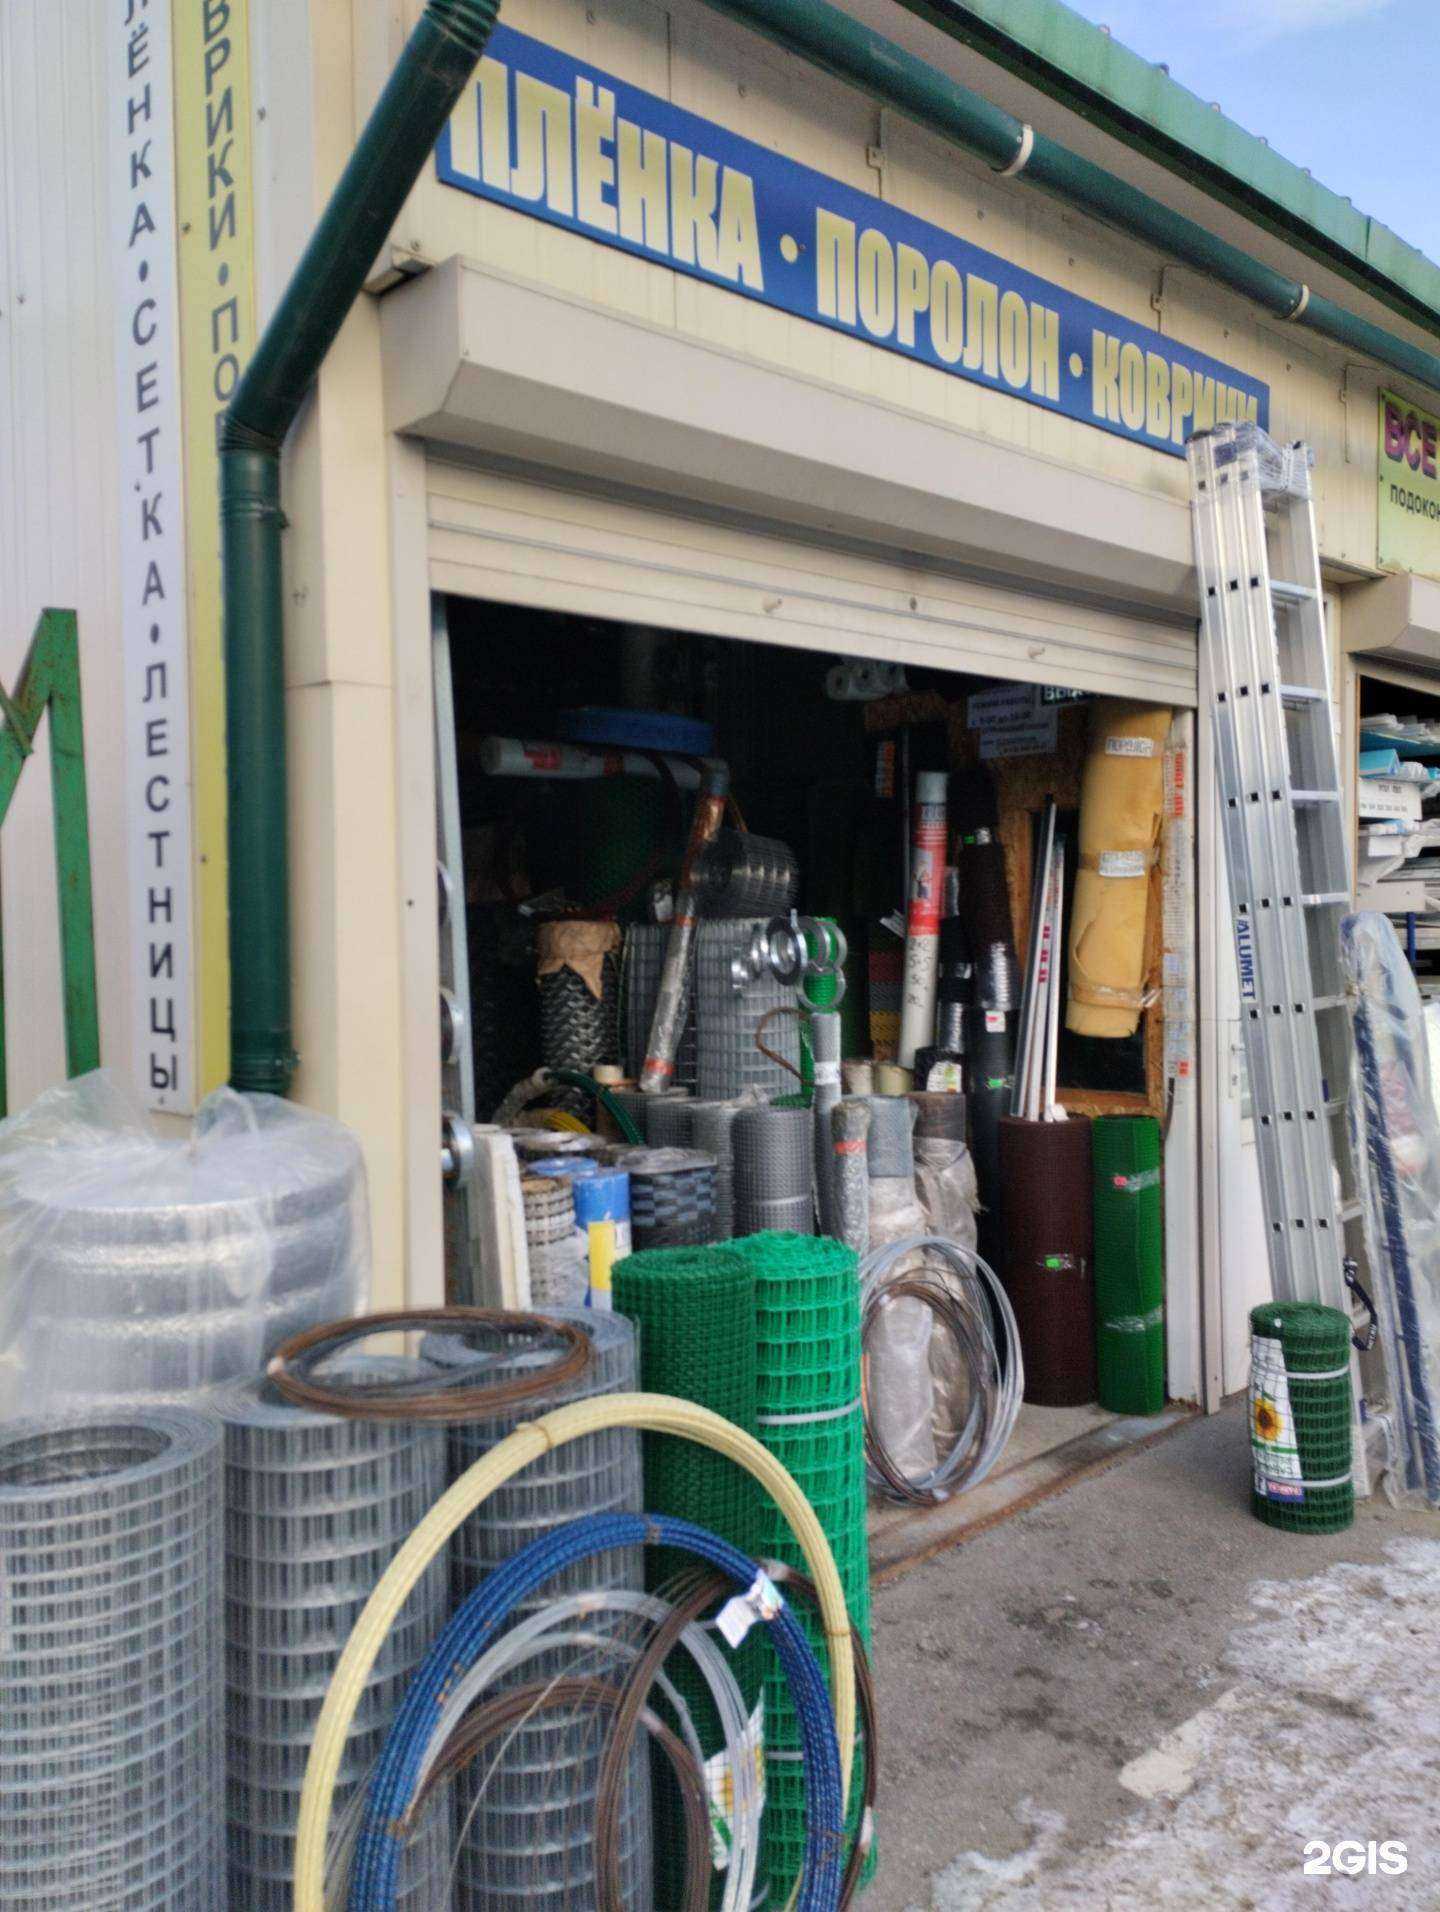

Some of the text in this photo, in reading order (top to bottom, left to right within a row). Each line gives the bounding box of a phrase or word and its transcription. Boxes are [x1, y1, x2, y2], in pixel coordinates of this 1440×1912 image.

[449, 54, 765, 293] ПЛЁНКА
[816, 207, 1060, 402] ПОРОЛОН
[132, 298, 166, 604] СЕТКА
[212, 296, 240, 457] ПО
[1384, 400, 1437, 480] ВСЕ
[142, 660, 178, 1091] ЛЕСТНИЦЫ
[1236, 918, 1256, 1000] ALUMET
